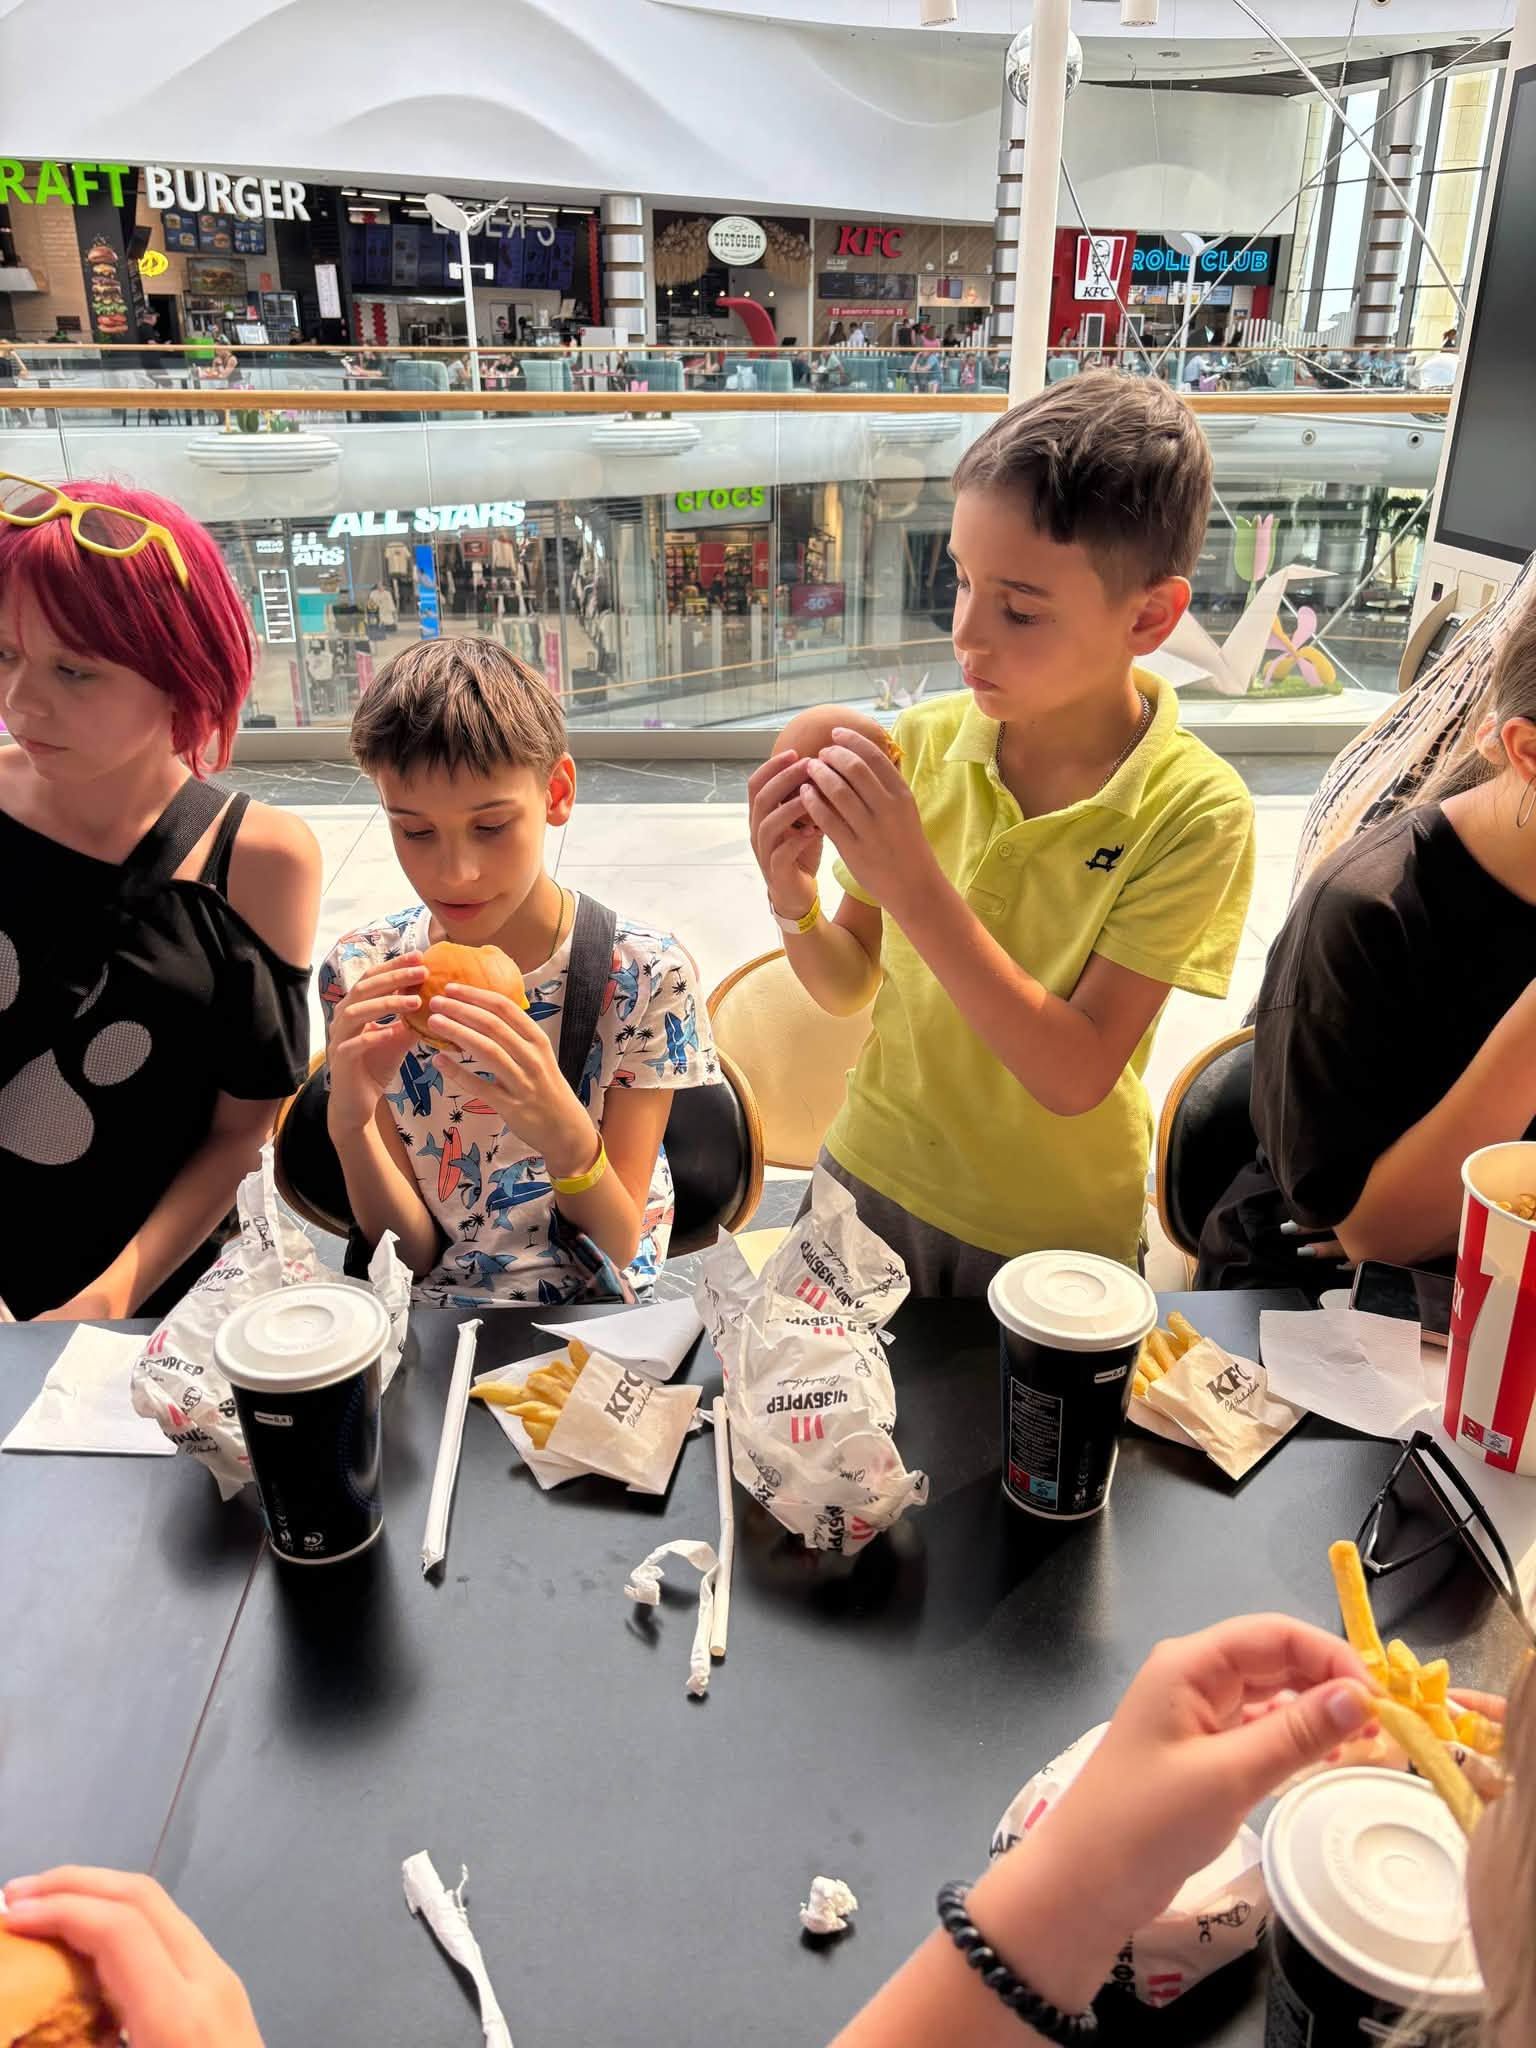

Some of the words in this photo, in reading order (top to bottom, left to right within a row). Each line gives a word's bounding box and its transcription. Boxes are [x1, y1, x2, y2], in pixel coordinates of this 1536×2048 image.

[143, 165, 312, 222] BURGER
[835, 225, 906, 259] KFC
[1131, 248, 1191, 272] ROLL
[1201, 248, 1268, 272] CLUB
[1082, 285, 1110, 298] KFC
[675, 486, 767, 513] crocs
[328, 511, 410, 538] ALL
[413, 501, 526, 533] STARS
[766, 1390, 848, 1414] ЧІЗБУРГЕР
